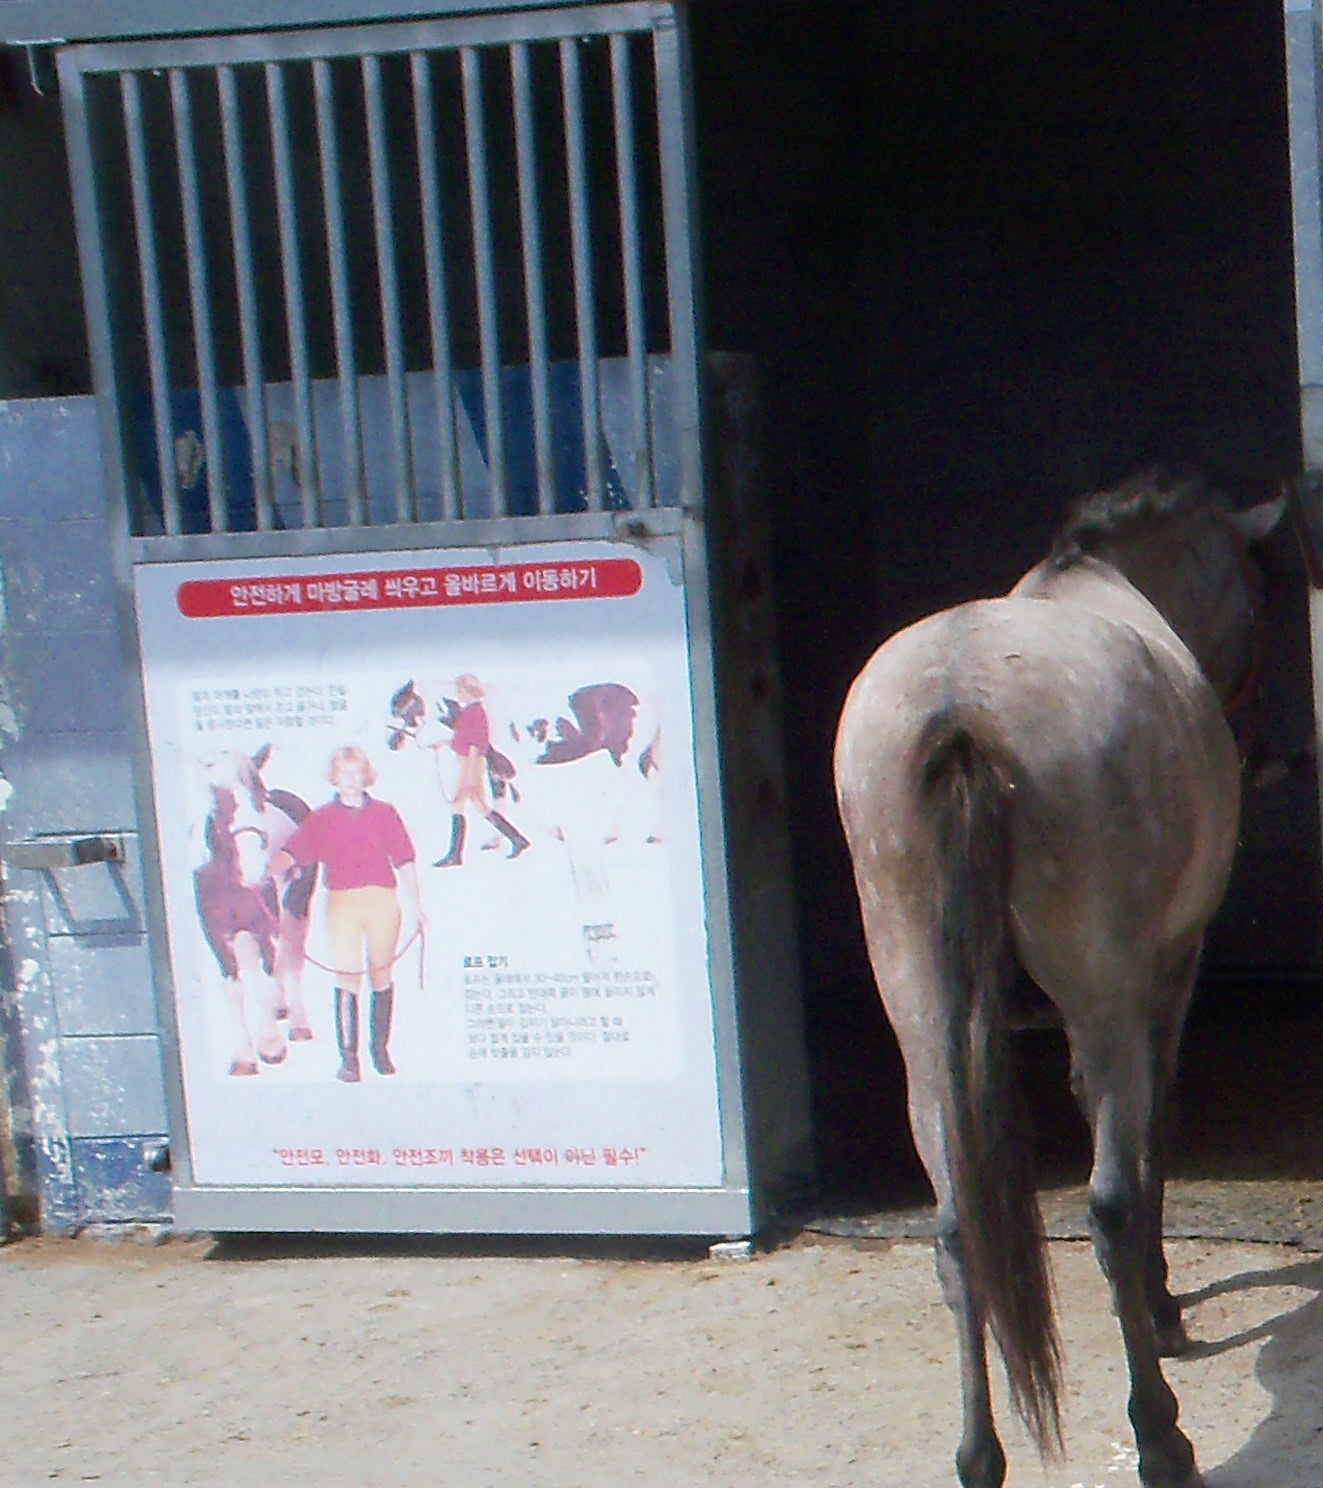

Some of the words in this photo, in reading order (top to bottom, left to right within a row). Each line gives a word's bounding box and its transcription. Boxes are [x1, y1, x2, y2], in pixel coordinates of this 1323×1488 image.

[230, 582, 301, 607] 안전하게
[306, 577, 377, 603] 마방굴레
[384, 575, 438, 599] 씌우고
[444, 570, 516, 597] 올바르게
[523, 566, 597, 592] 이동하기
[393, 1148, 454, 1166] 안전조끼
[461, 1147, 506, 1167] 착용은
[514, 1147, 560, 1166] 선택이
[565, 1147, 596, 1166] 아닌
